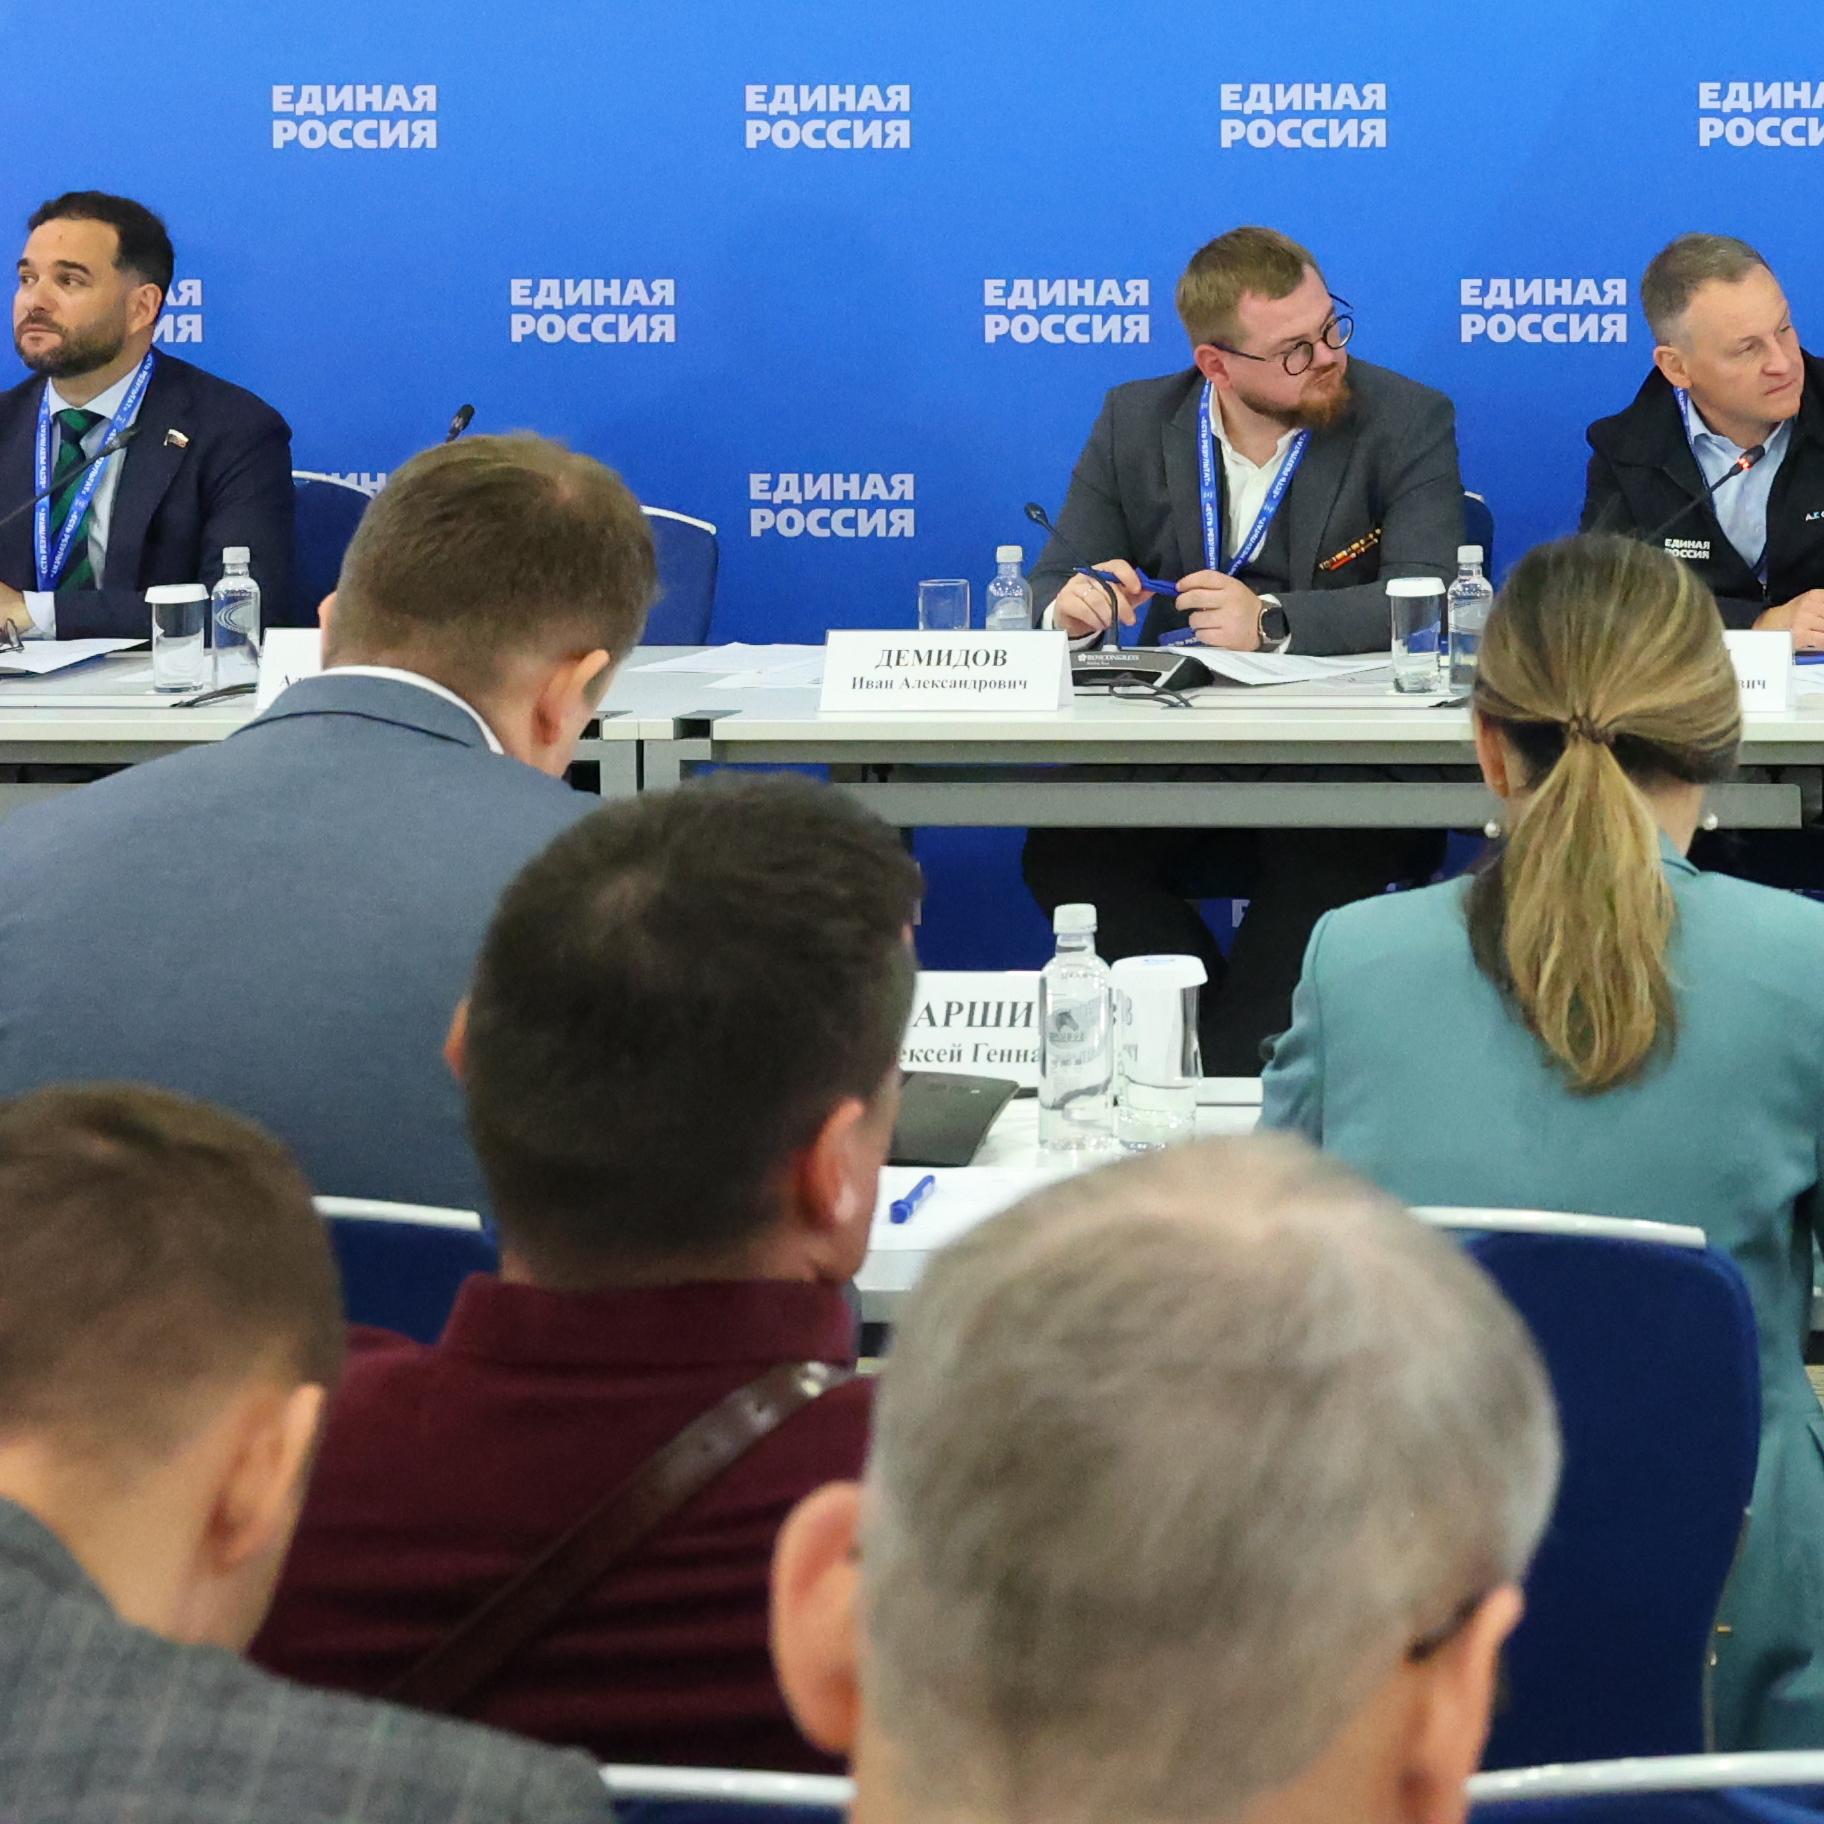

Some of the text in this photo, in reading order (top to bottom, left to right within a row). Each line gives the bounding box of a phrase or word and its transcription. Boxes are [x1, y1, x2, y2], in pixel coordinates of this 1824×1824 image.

[273, 85, 436, 115] ЕДИНАЯ
[746, 85, 910, 115] ЕДИНАЯ
[1221, 84, 1386, 114] ЕДИНАЯ
[273, 120, 436, 148] РОССИЯ
[746, 120, 910, 148] РОССИЯ
[1221, 119, 1386, 147] РОССИЯ
[511, 279, 674, 309] ЕДИНАЯ
[985, 279, 1149, 309] ЕДИНАЯ
[1461, 279, 1626, 309] ЕДИНАЯ
[512, 314, 675, 342] РОССИЯ
[985, 314, 1149, 343] РОССИЯ
[1462, 314, 1626, 342] РОССИЯ
[750, 474, 913, 503] ЕДИНАЯ
[751, 509, 914, 536] РОССИЯ
[1206, 527, 1216, 570] РЕЗУЛЬТАТ
[1664, 538, 1711, 550] ЕДИНАЯ
[875, 650, 1007, 669] ДЕМИДОВ
[852, 677, 1027, 692] Иван Александрович
[912, 1000, 1036, 1028] АРШИ
[901, 1042, 1040, 1063] ексей Генна
